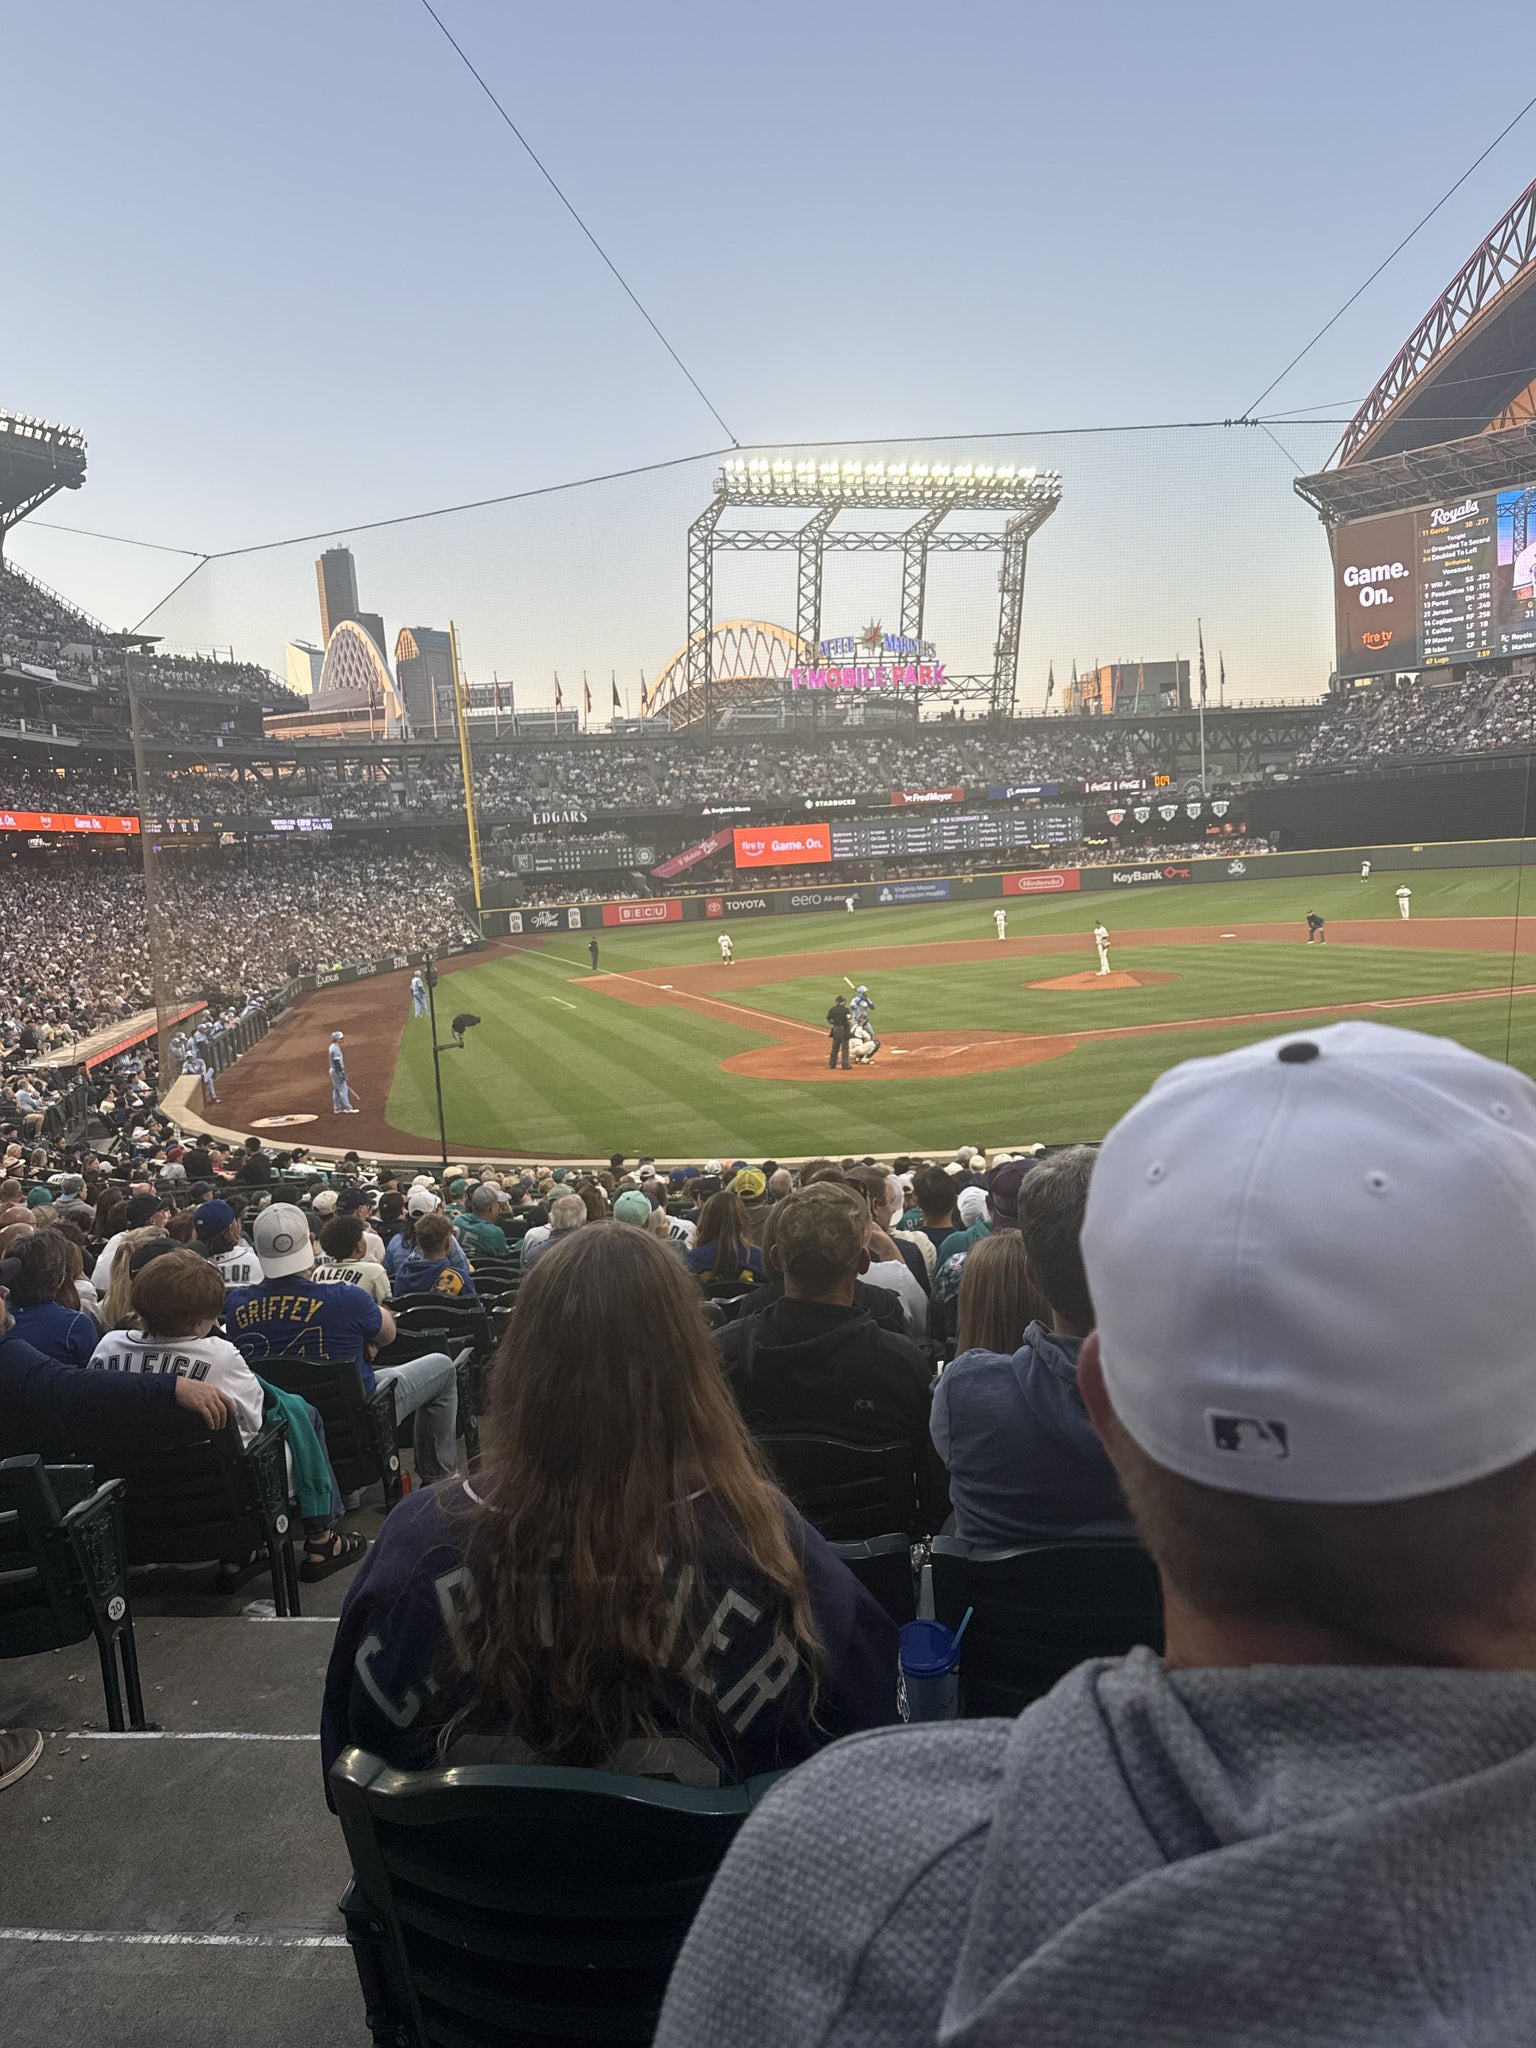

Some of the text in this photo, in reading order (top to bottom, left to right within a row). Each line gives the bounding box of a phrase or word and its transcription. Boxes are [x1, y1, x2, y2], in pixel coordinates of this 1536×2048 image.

[1431, 500, 1479, 527] Royals
[1430, 526, 1449, 535] Garcia
[1431, 542, 1460, 553] Grounded
[1468, 536, 1491, 546] Second
[1431, 551, 1456, 561] Doubled
[1465, 547, 1478, 555] Left
[1344, 562, 1410, 587] Game.
[1442, 565, 1473, 575] Venezuela
[1359, 587, 1394, 607] On.
[1362, 631, 1392, 643] fire tv
[1512, 632, 1533, 641] Royals
[1434, 657, 1449, 665] Lugo
[790, 664, 947, 690] T-MOBILE PARK
[533, 810, 588, 825] EDGARS
[741, 841, 766, 850] fire tv
[771, 840, 805, 851] Game.
[806, 838, 823, 849] On.
[1113, 869, 1162, 883] KeyBank
[894, 883, 936, 893] Virginia Mason
[1023, 879, 1060, 887] Nintendo
[791, 894, 822, 906] eero
[894, 889, 946, 899] Franciscan Health
[726, 899, 766, 910] TOYOTA
[623, 905, 663, 918] BECU
[235, 1296, 323, 1329] GRIFFEY
[111, 1601, 122, 1616] 20
